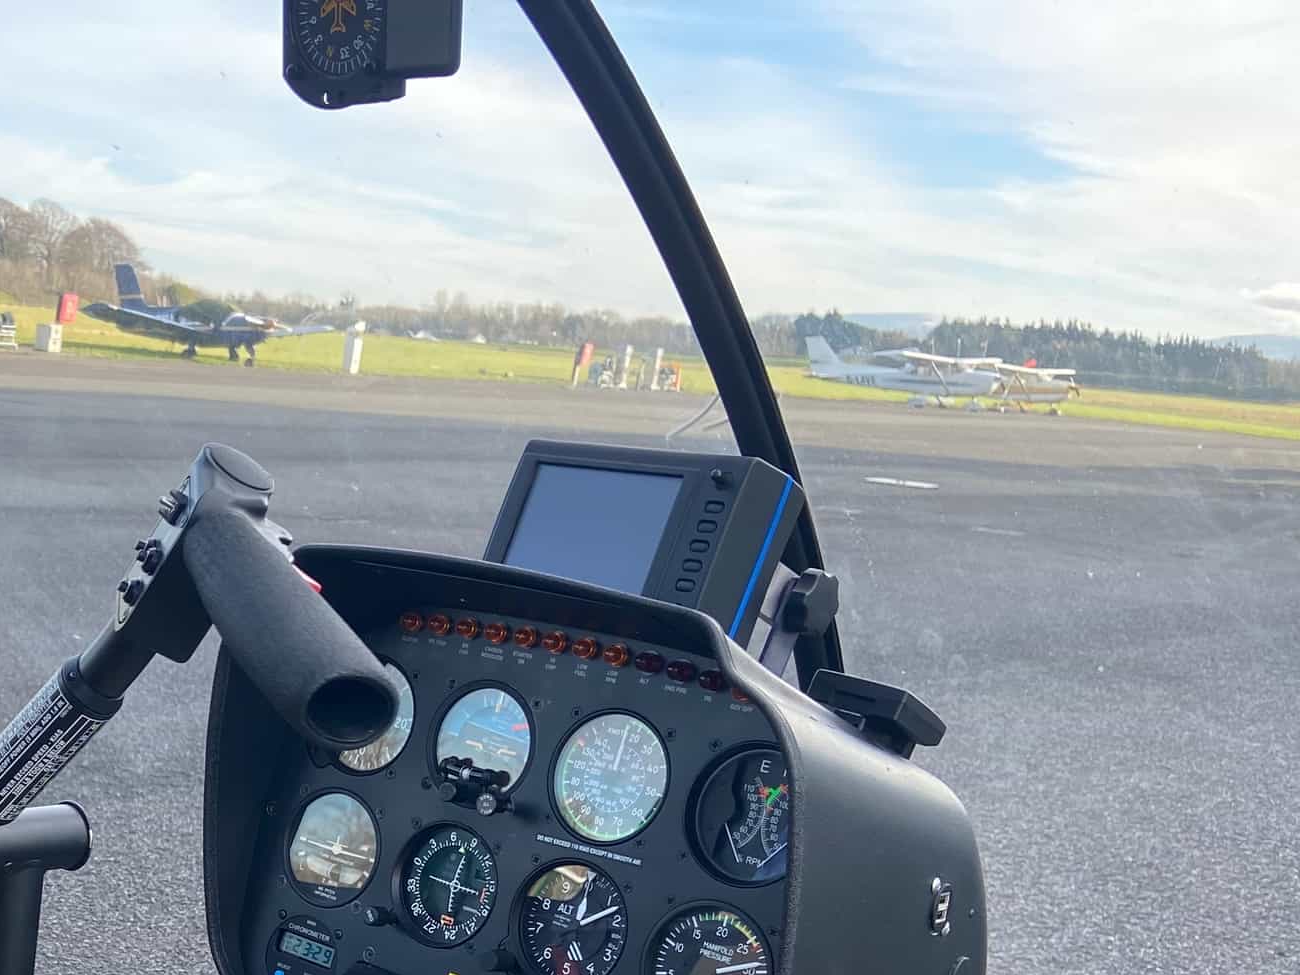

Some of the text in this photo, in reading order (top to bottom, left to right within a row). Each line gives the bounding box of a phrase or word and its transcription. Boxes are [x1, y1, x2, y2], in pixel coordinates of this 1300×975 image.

[642, 745, 652, 754] 30
[13, 759, 35, 782] EXCEED
[31, 743, 50, 763] SPEED
[760, 760, 772, 773] E
[572, 791, 585, 801] 100
[645, 787, 655, 797] 50
[581, 805, 591, 815] 90
[632, 808, 643, 817] 60
[595, 816, 604, 826] 80
[613, 816, 623, 826] 70
[469, 838, 478, 848] 9
[413, 857, 422, 866] 0
[484, 854, 493, 866] 12
[407, 879, 416, 892] 33
[562, 881, 571, 893] 9
[411, 902, 422, 917] 30
[542, 898, 551, 910] 8
[557, 903, 575, 915] ALT
[611, 915, 621, 927] 2
[423, 921, 437, 934] 27
[465, 922, 477, 935] 21
[535, 922, 544, 934] 7
[716, 927, 728, 938] 20
[444, 930, 456, 940] 24
[692, 929, 702, 940] 15
[543, 947, 553, 960] 6
[675, 943, 684, 953] 10
[702, 941, 734, 956] MANIFOLD
[736, 944, 749, 955] 25
[603, 949, 612, 961] 3
[699, 948, 733, 965] PRESSURE
[562, 962, 571, 975] 5
[586, 962, 595, 973] 4
